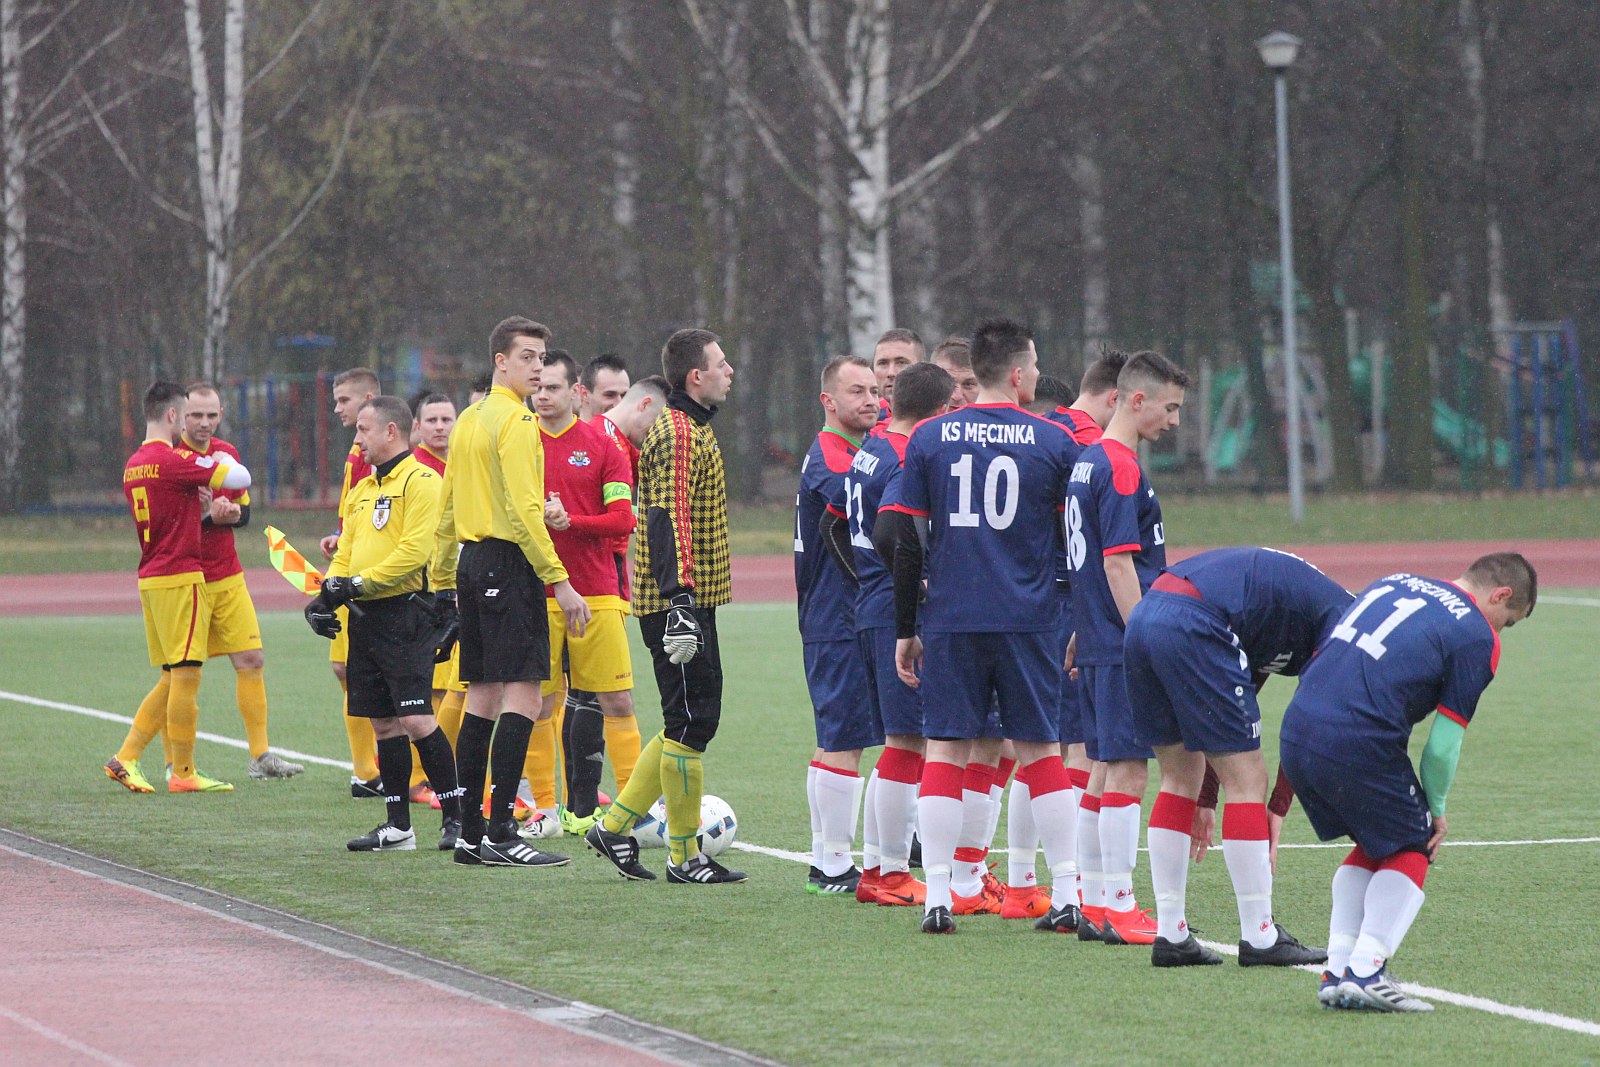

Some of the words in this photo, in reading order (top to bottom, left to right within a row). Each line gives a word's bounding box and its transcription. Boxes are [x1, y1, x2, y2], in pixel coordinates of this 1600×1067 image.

[941, 421, 961, 442] KS
[964, 422, 1036, 448] MĘCINKA
[131, 486, 151, 543] 9
[949, 454, 1020, 530] 10
[1330, 585, 1427, 660] 11
